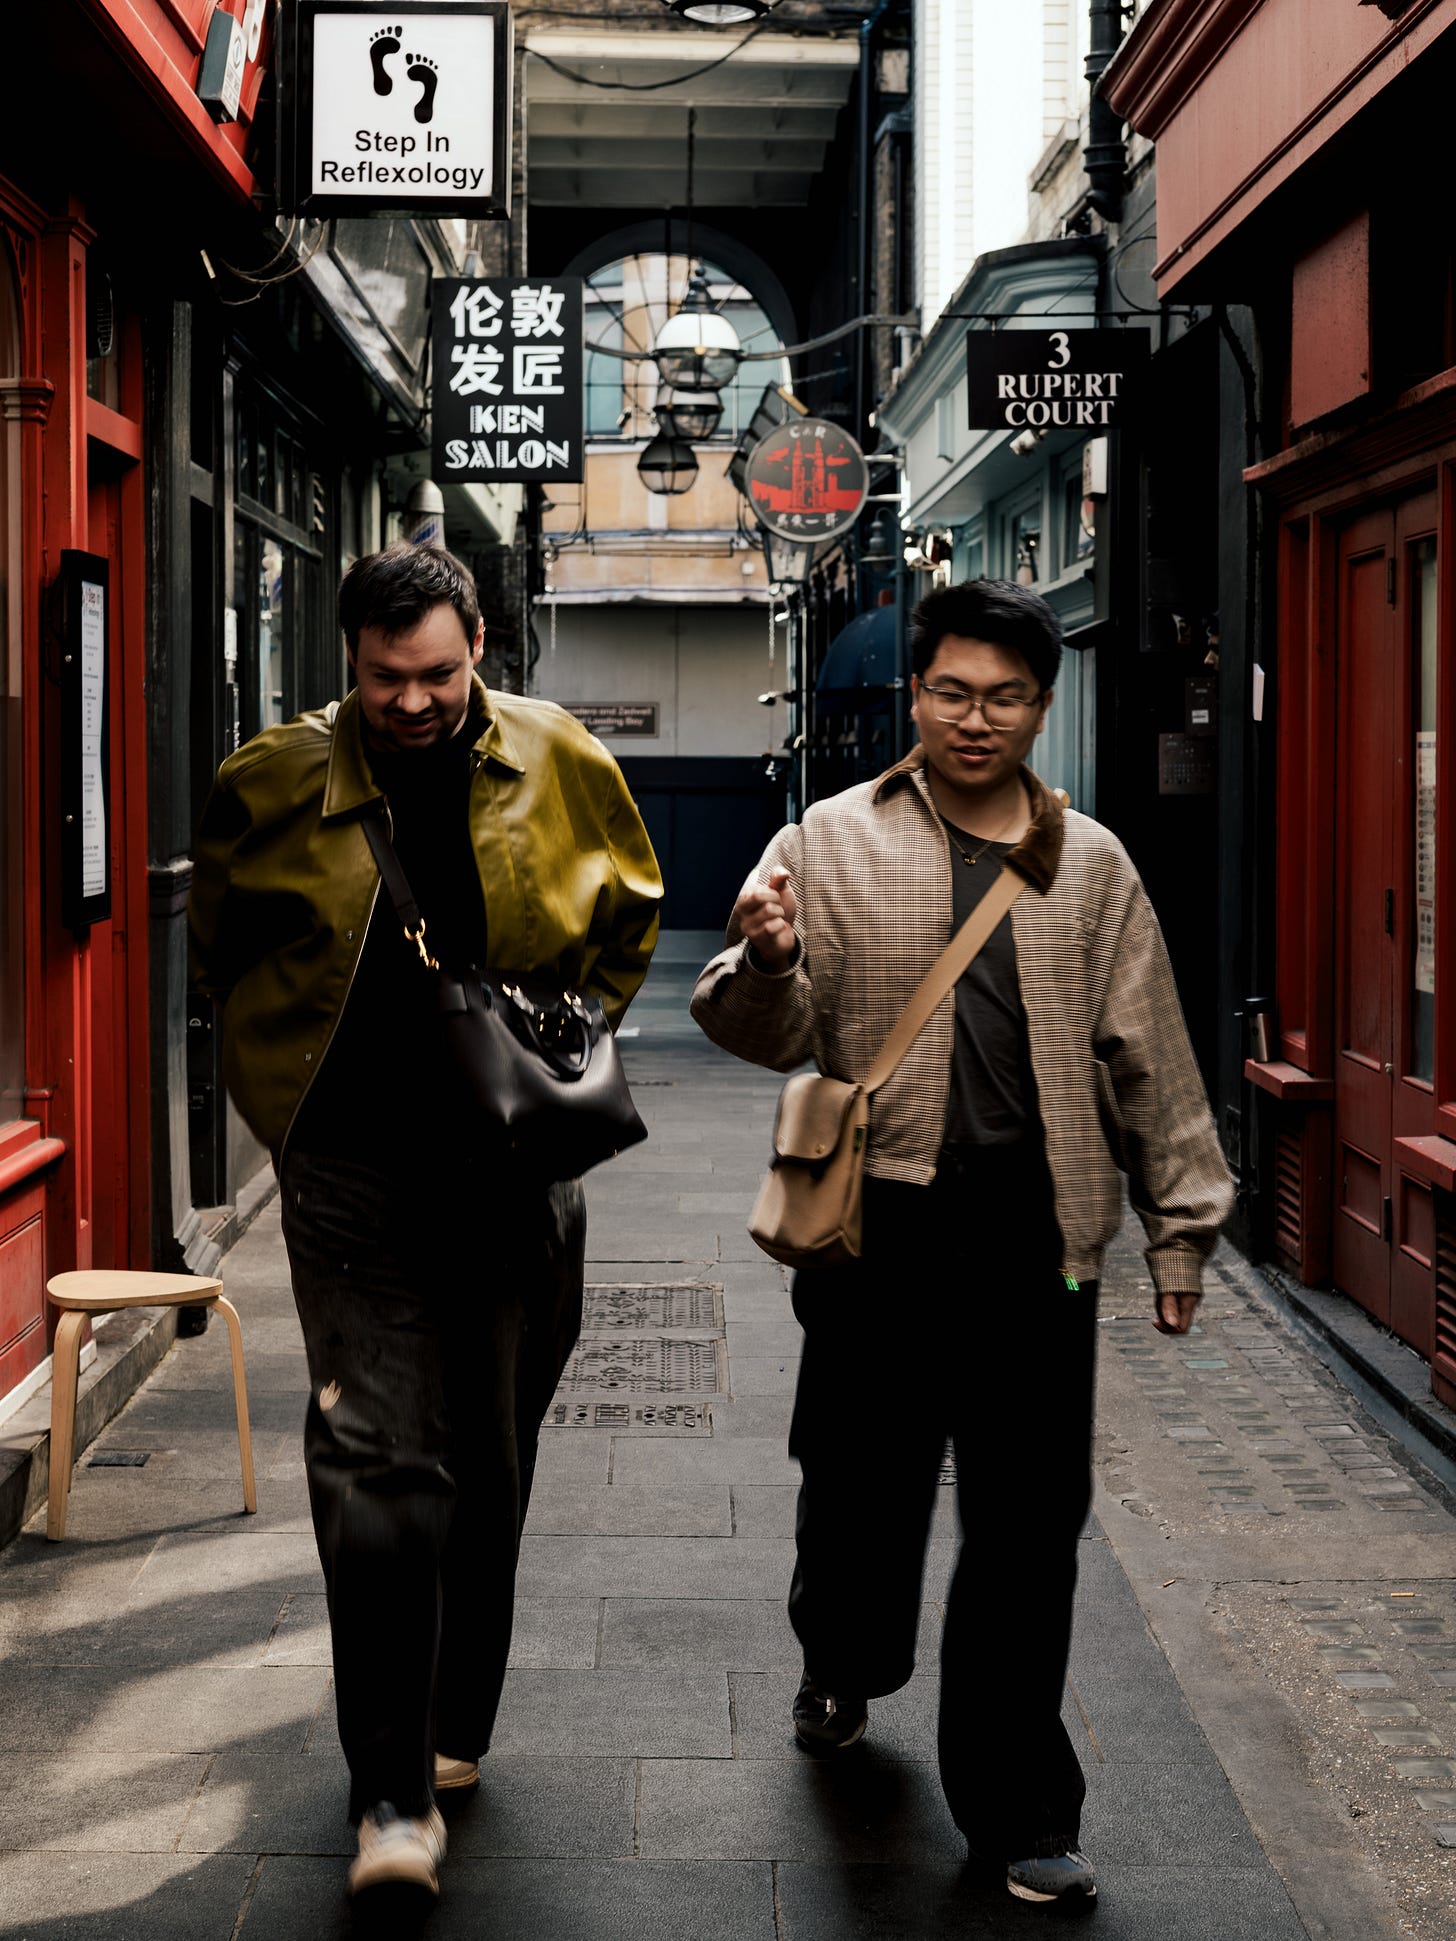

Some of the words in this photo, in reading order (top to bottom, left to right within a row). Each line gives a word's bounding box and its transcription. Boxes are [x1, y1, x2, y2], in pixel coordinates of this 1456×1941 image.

[355, 130, 416, 157] Step
[427, 131, 450, 152] In
[321, 161, 485, 189] Reflexology
[449, 285, 565, 338] 伦敦
[1047, 332, 1071, 369] 3
[449, 343, 565, 396] 发匠
[997, 373, 1123, 398] RUPERT
[469, 405, 545, 434] KEN
[1004, 401, 1115, 426] COURT
[445, 439, 570, 469] SALON
